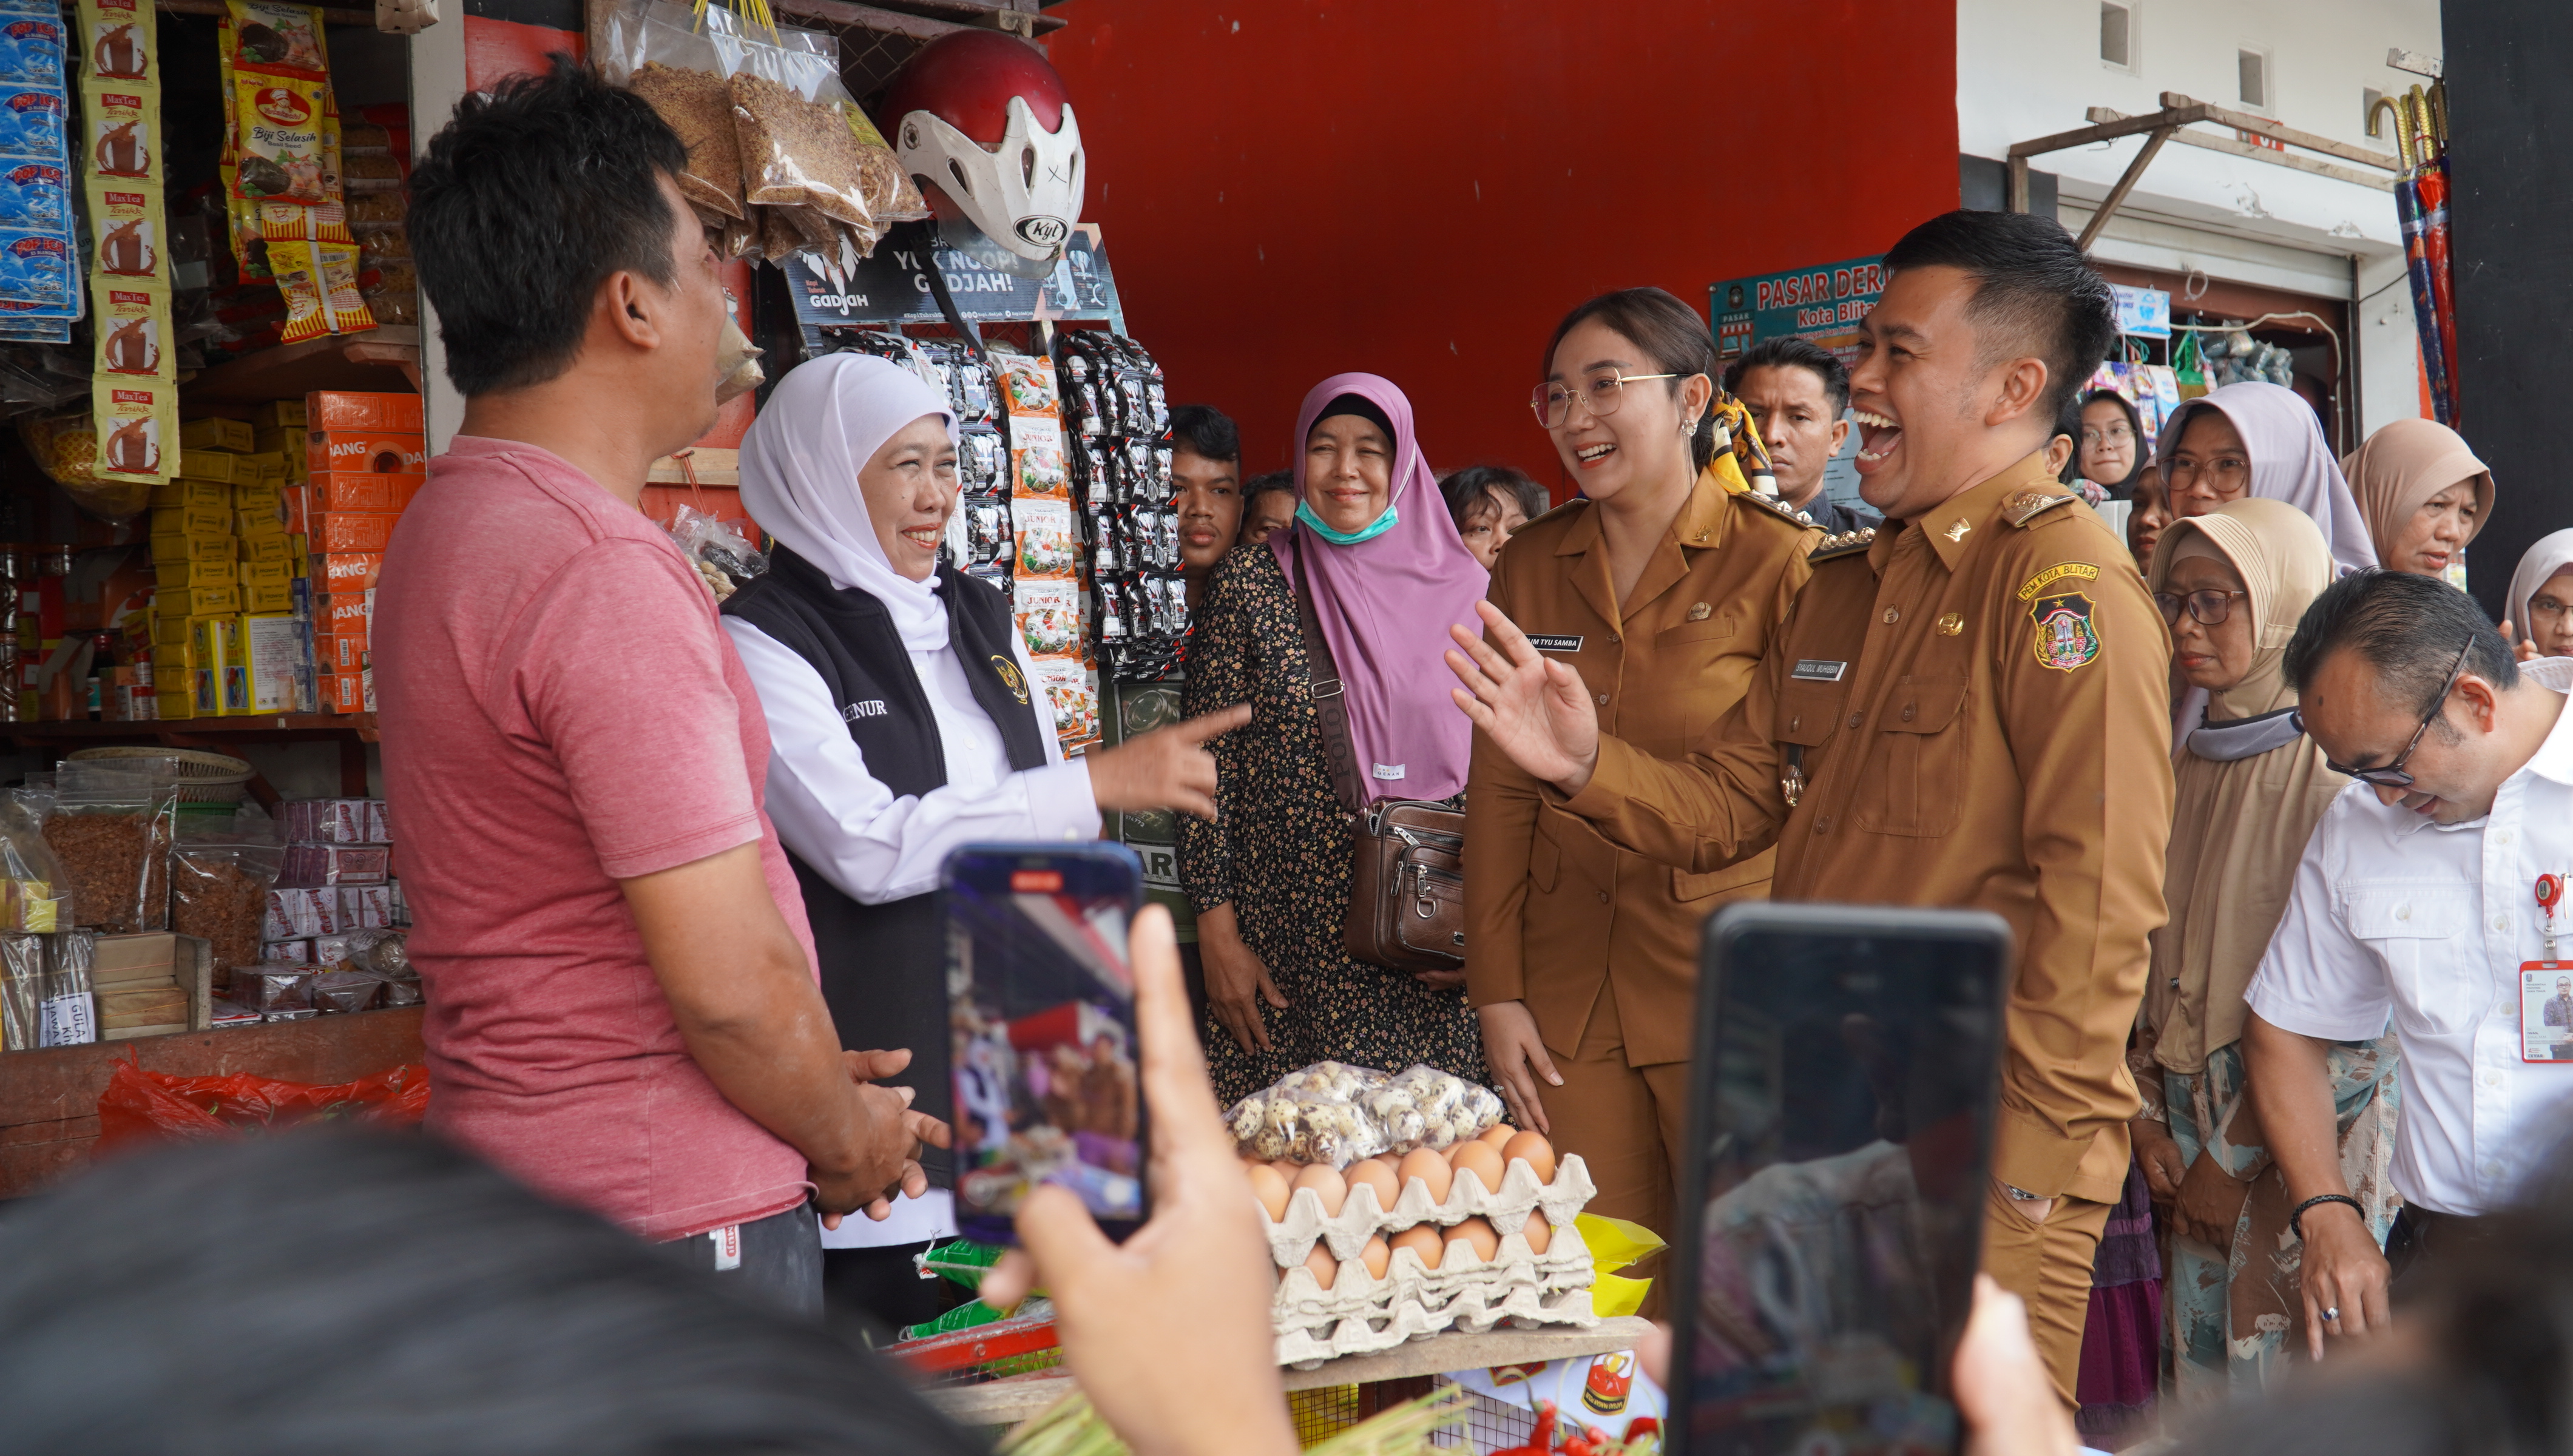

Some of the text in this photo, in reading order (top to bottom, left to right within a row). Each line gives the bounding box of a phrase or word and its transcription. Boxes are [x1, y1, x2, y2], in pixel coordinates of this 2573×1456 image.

[247, 3, 310, 16] Biji Selasih
[12, 23, 34, 36] POP
[13, 95, 37, 109] POP
[106, 98, 138, 107] MaxTea
[252, 126, 317, 143] Biji Selasih
[14, 167, 38, 181] POP
[1033, 222, 1060, 240] Kyt
[16, 239, 41, 254] POP
[914, 273, 1013, 293] GDJAH!
[114, 294, 146, 302] MaxTea
[1757, 271, 1830, 311] PASAR
[1723, 312, 1750, 323] PASAR
[1798, 306, 1834, 329] Kota
[117, 393, 149, 402] MaxTea
[1023, 433, 1053, 442] JUNIOR
[403, 451, 426, 465] DA
[1025, 515, 1056, 524] JUNIOR
[2020, 564, 2097, 599] PEM KOTA BLITAR
[1027, 596, 1061, 605] JUNIOR
[1554, 639, 1577, 647] SAMBA
[72, 1004, 86, 1038] GULA
